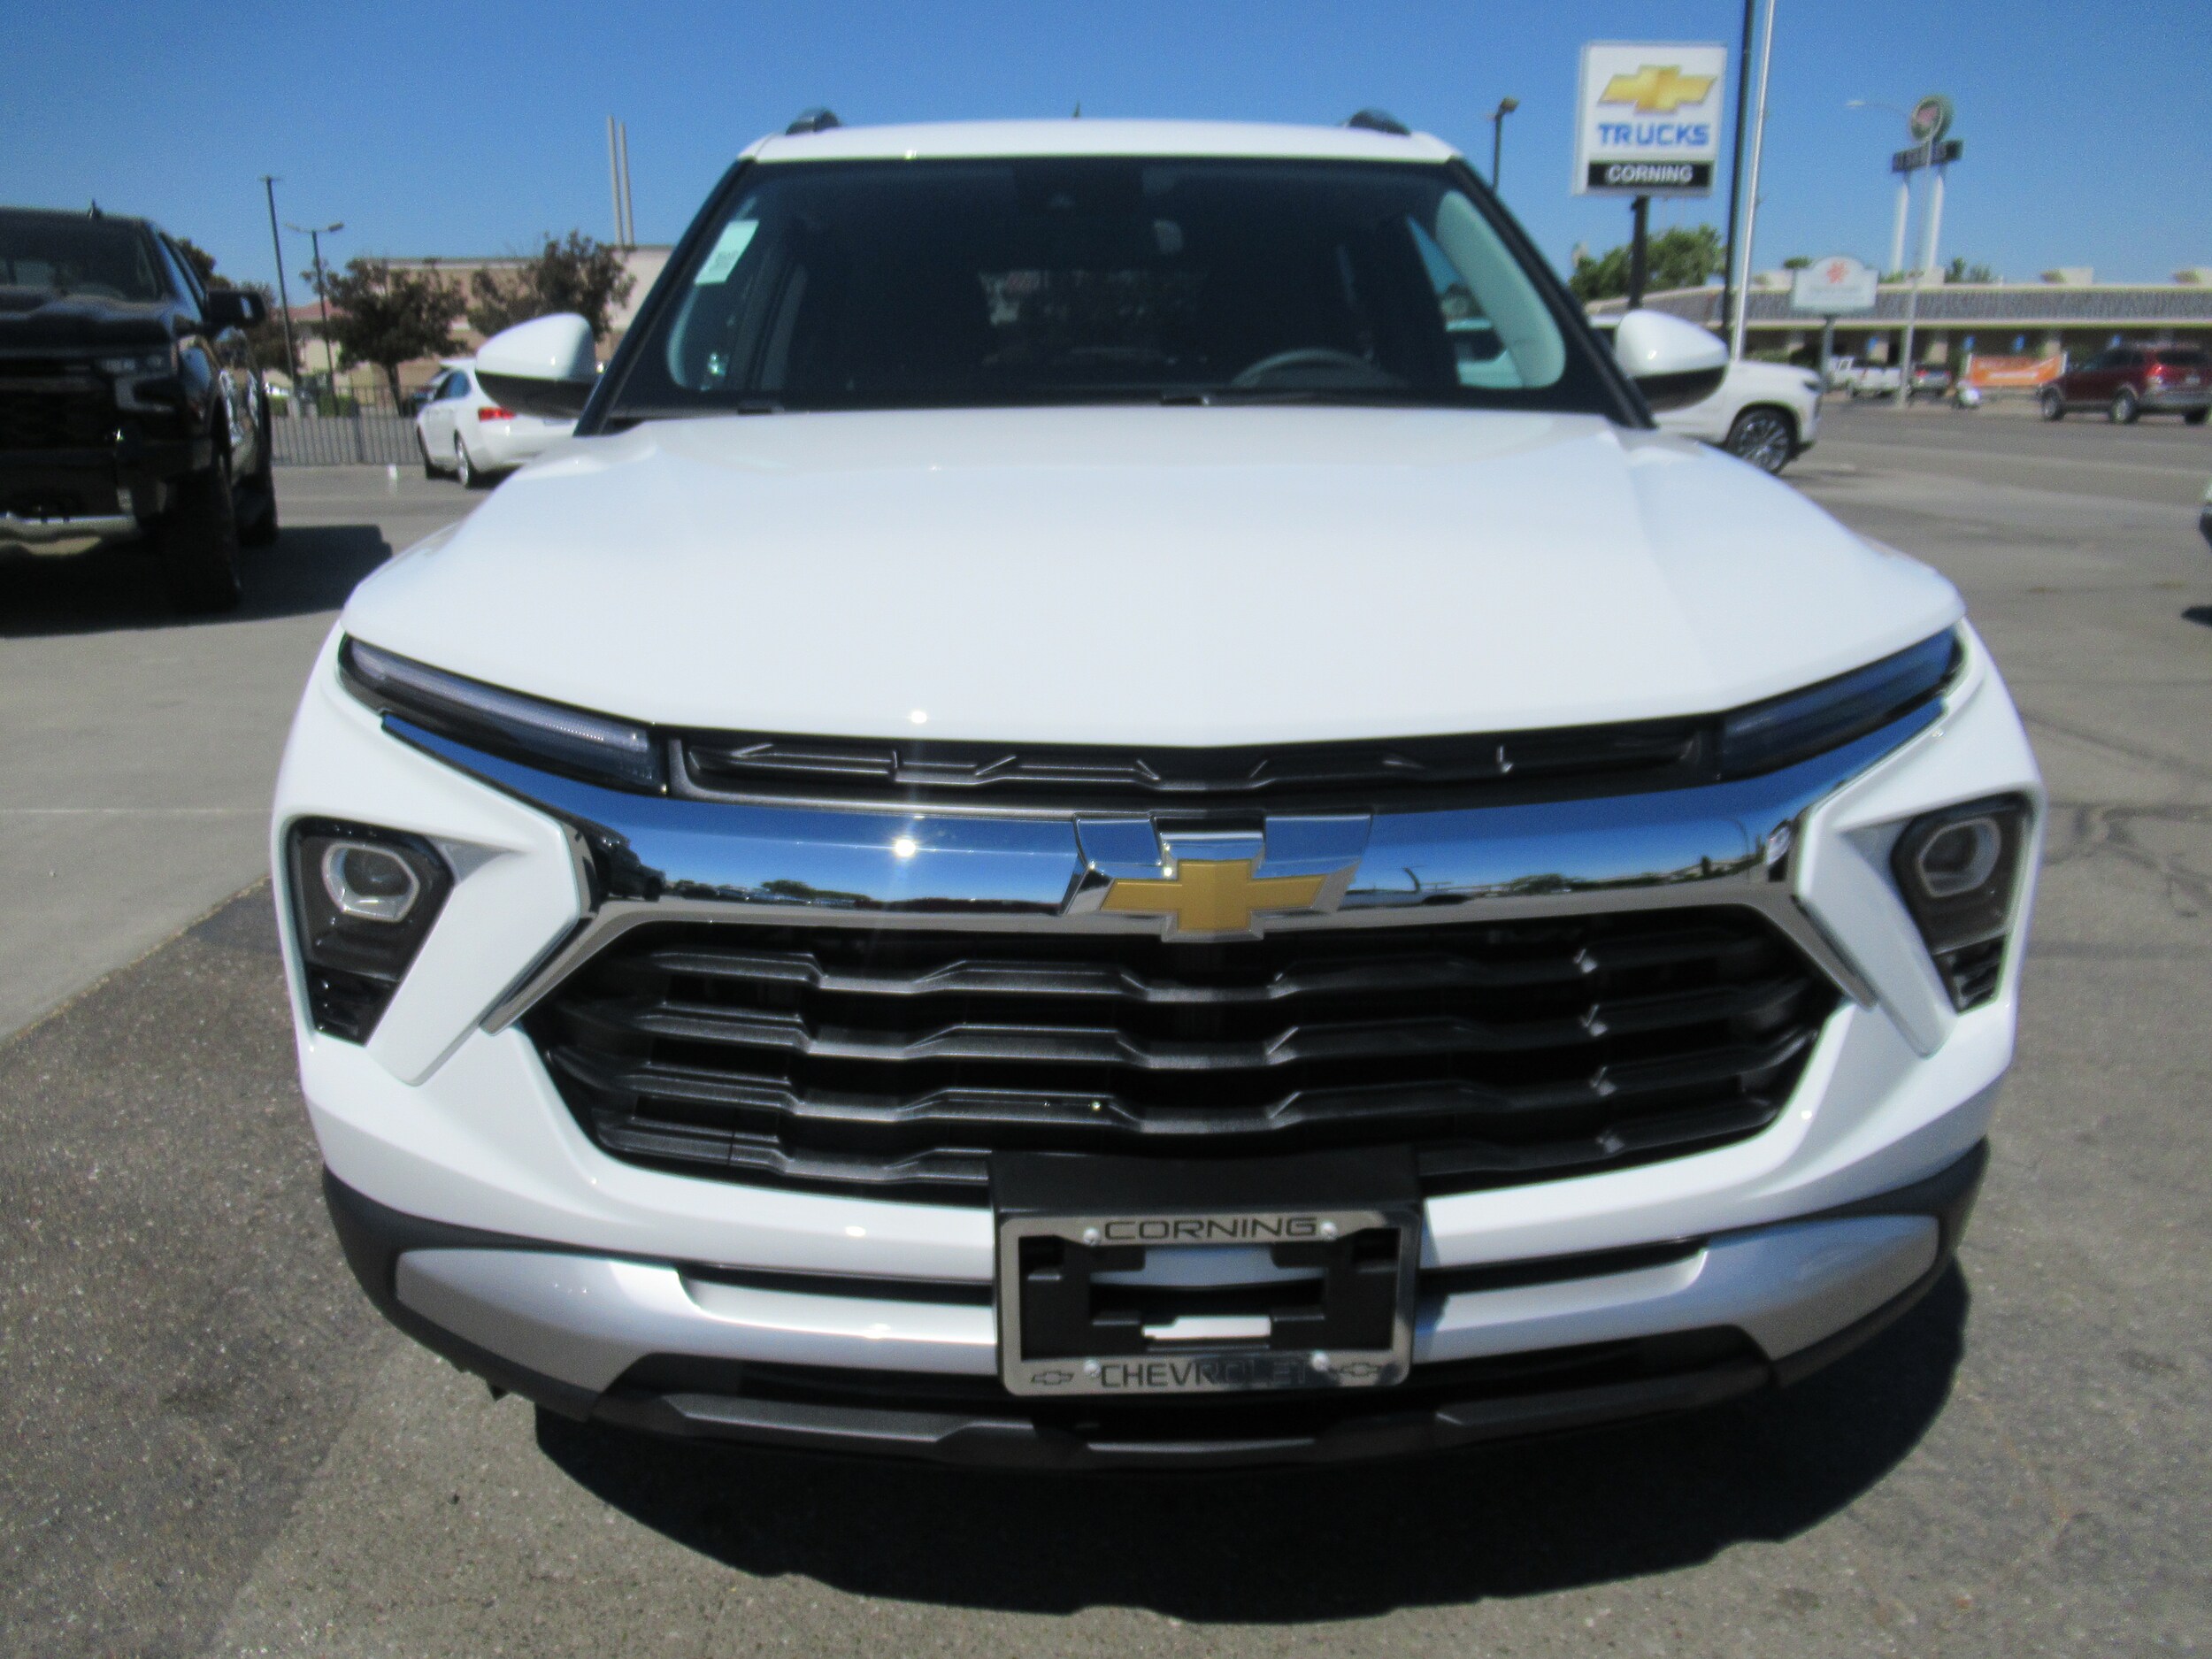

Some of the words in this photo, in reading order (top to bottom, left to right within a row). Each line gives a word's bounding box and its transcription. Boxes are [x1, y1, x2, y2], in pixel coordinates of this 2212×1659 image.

[1598, 123, 1709, 146] TRUCKS
[1606, 165, 1694, 183] CORNING
[1105, 1217, 1317, 1240] CORNING
